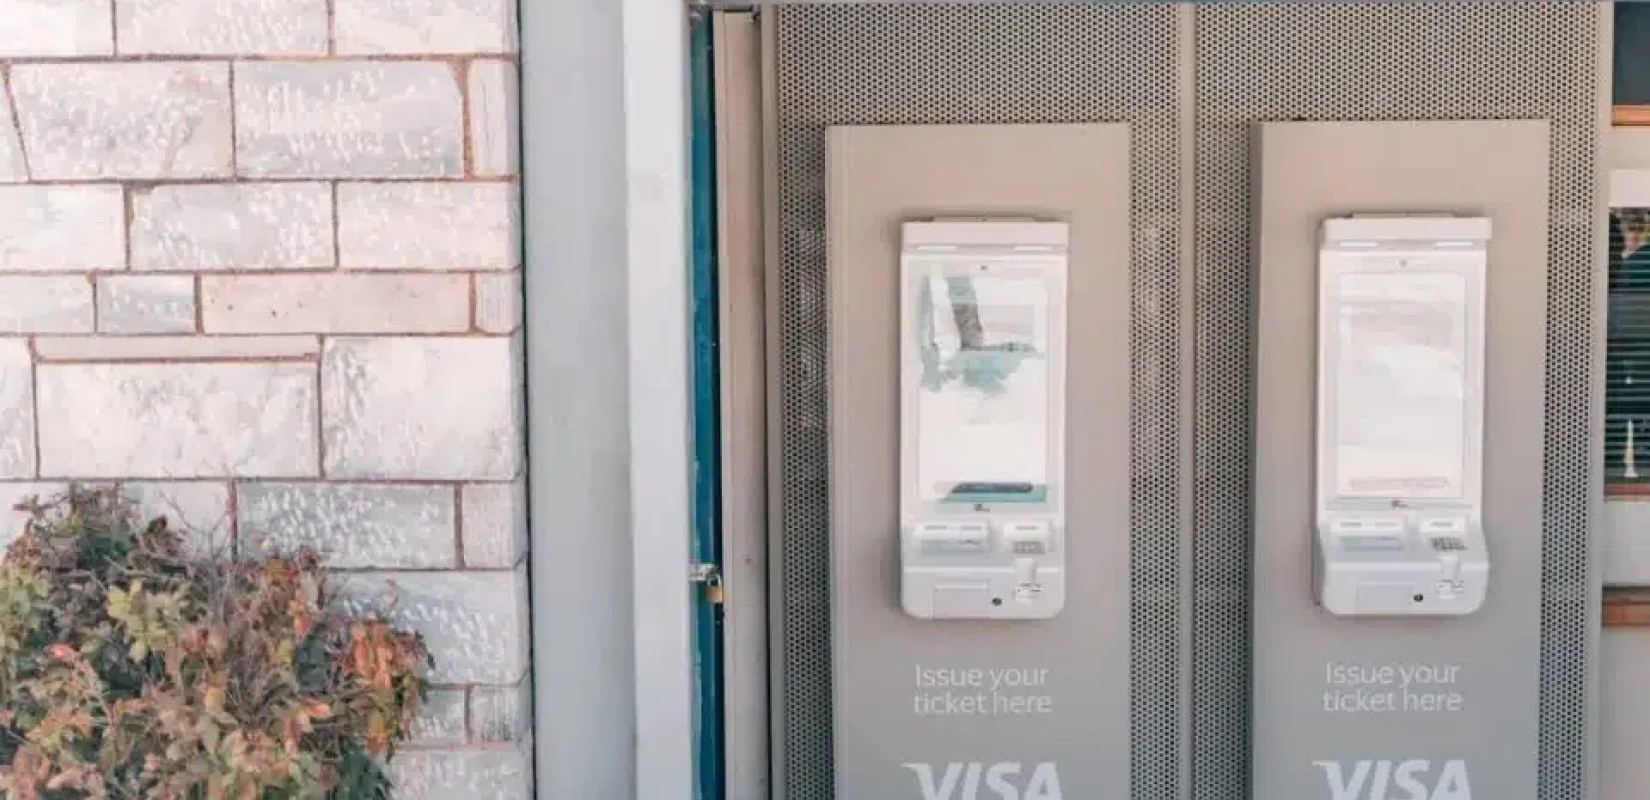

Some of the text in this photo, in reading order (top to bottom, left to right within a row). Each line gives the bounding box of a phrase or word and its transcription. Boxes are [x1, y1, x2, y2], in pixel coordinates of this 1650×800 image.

[915, 664, 1048, 691] Issue your
[1325, 661, 1462, 688] Issue your
[914, 690, 1053, 714] ticket here
[1322, 688, 1464, 711] ticket here
[901, 761, 1063, 800] VISA
[1312, 759, 1472, 800] VISA
